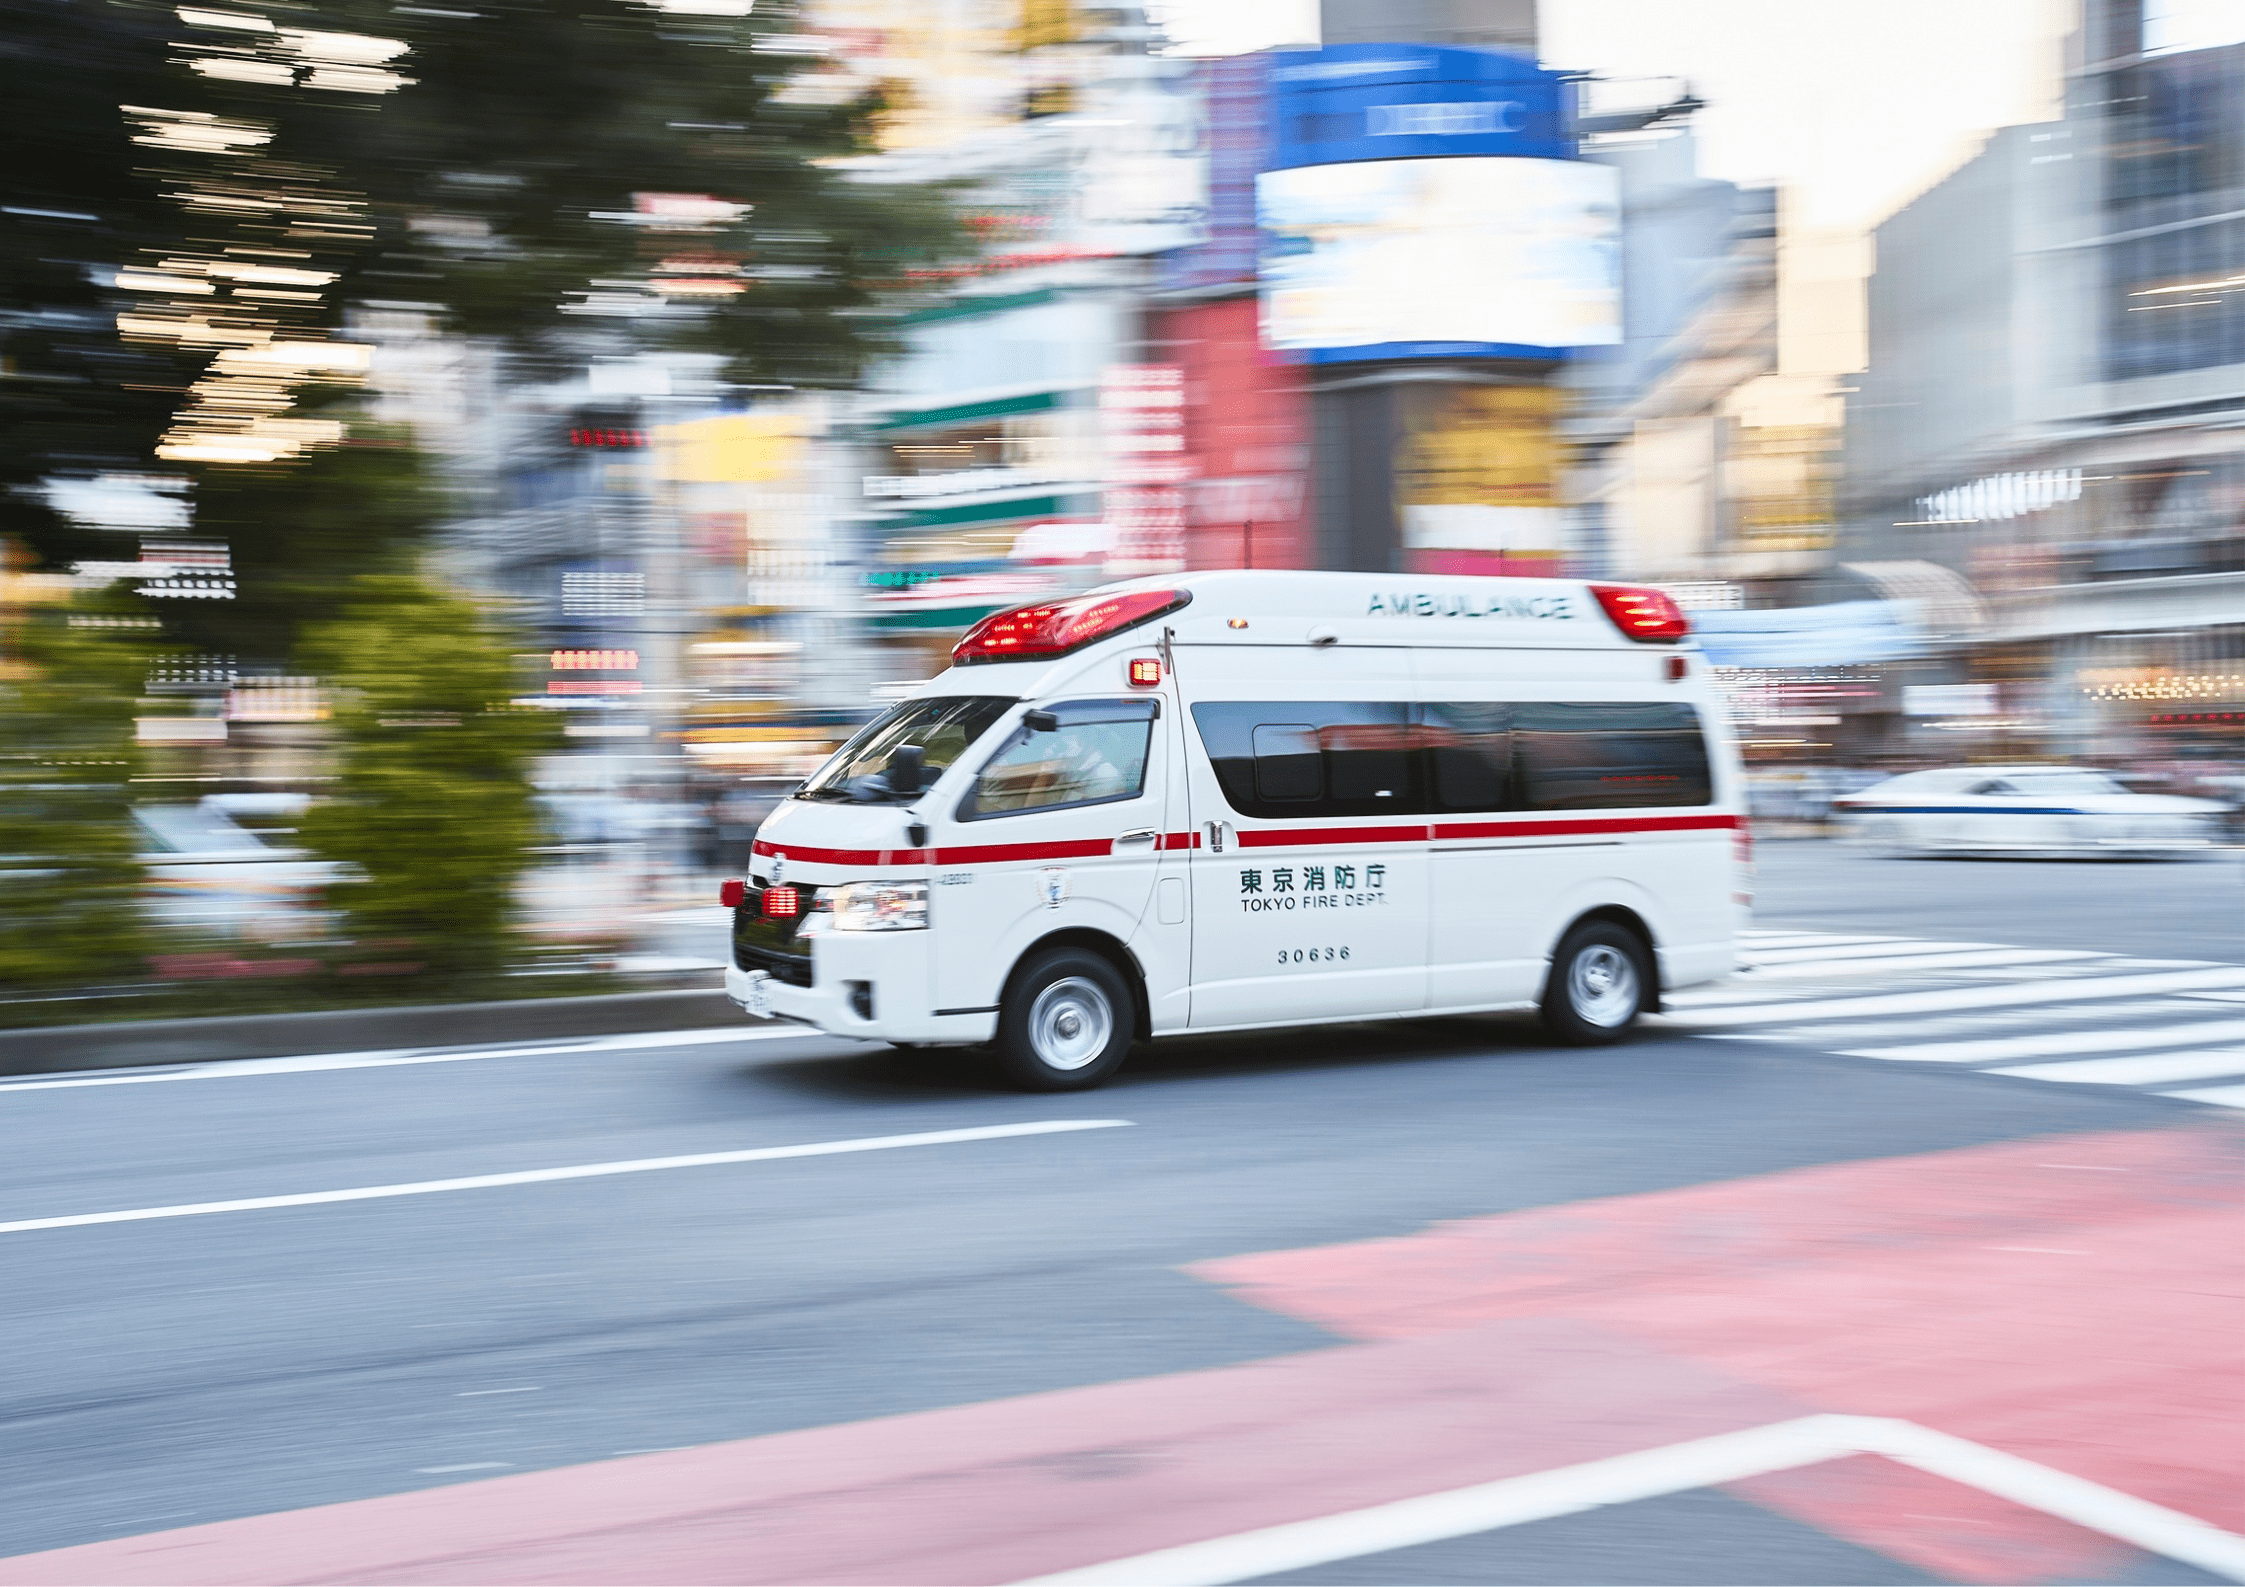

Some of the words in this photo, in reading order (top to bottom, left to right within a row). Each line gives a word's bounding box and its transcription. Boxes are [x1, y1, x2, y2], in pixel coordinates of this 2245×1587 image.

[1367, 594, 1574, 619] AMBULANCE
[1240, 864, 1386, 894] 東京消防庁
[1241, 897, 1296, 912] TOKYO
[1303, 895, 1338, 909] FIRE
[1278, 946, 1350, 964] 30636
